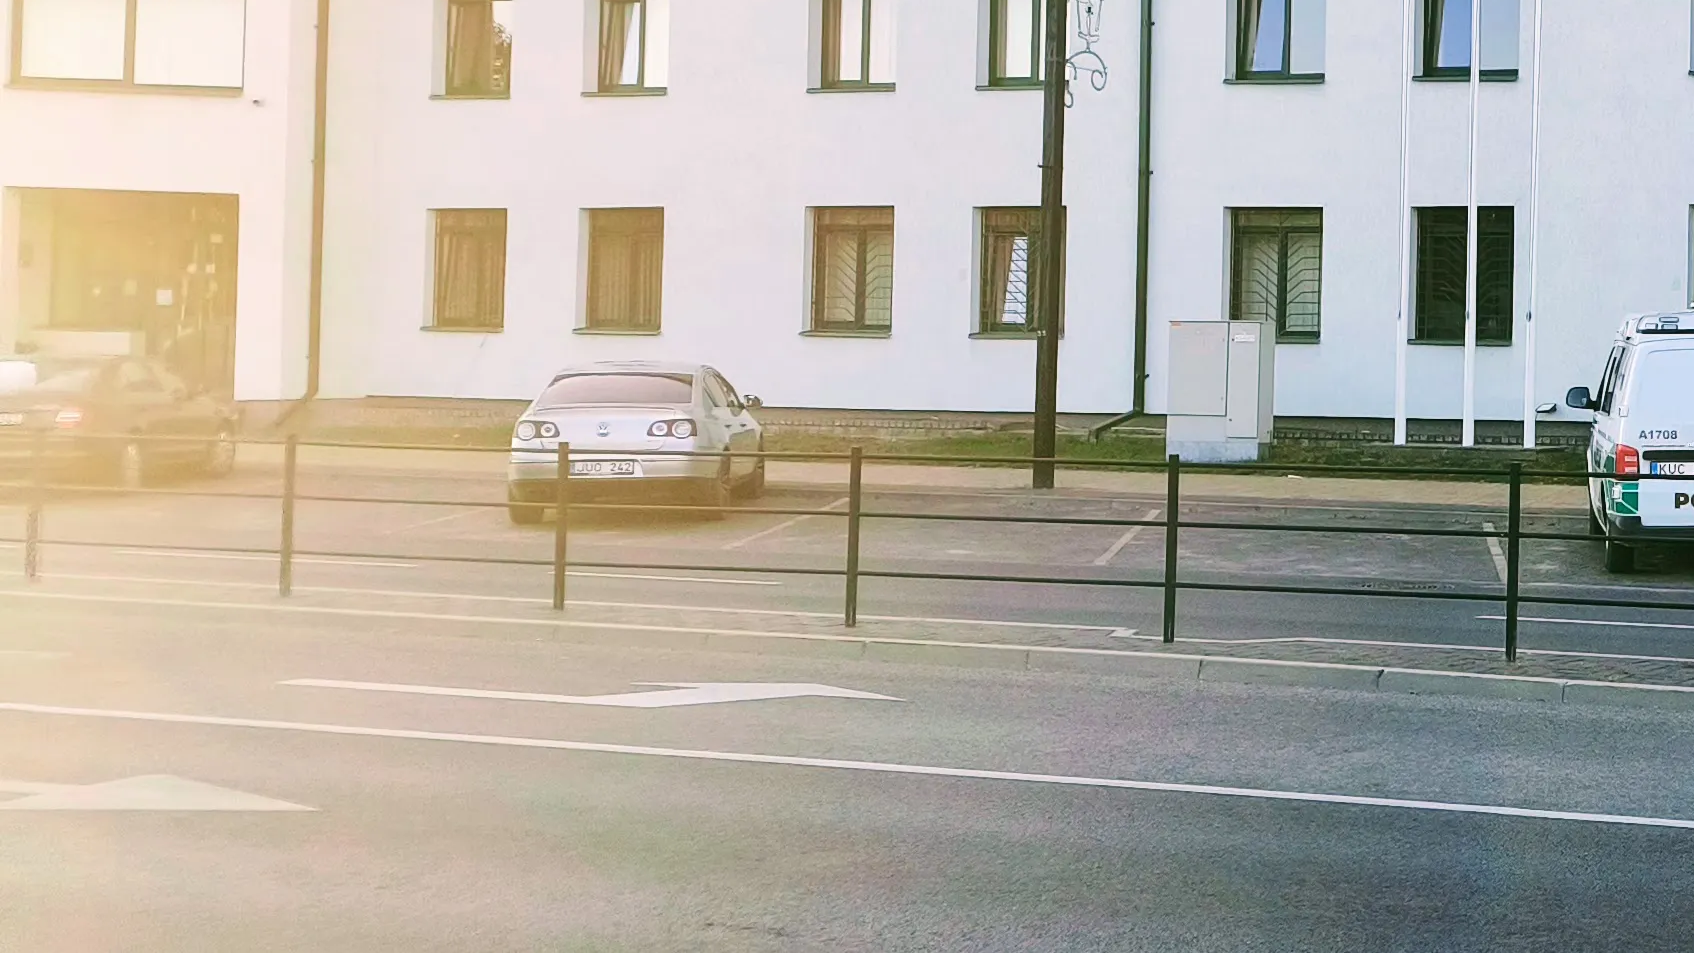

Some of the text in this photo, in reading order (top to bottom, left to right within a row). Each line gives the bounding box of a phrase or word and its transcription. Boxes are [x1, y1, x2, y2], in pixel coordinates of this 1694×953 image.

[1639, 429, 1678, 440] A1708
[610, 462, 631, 472] 242
[1660, 463, 1685, 475] KUC
